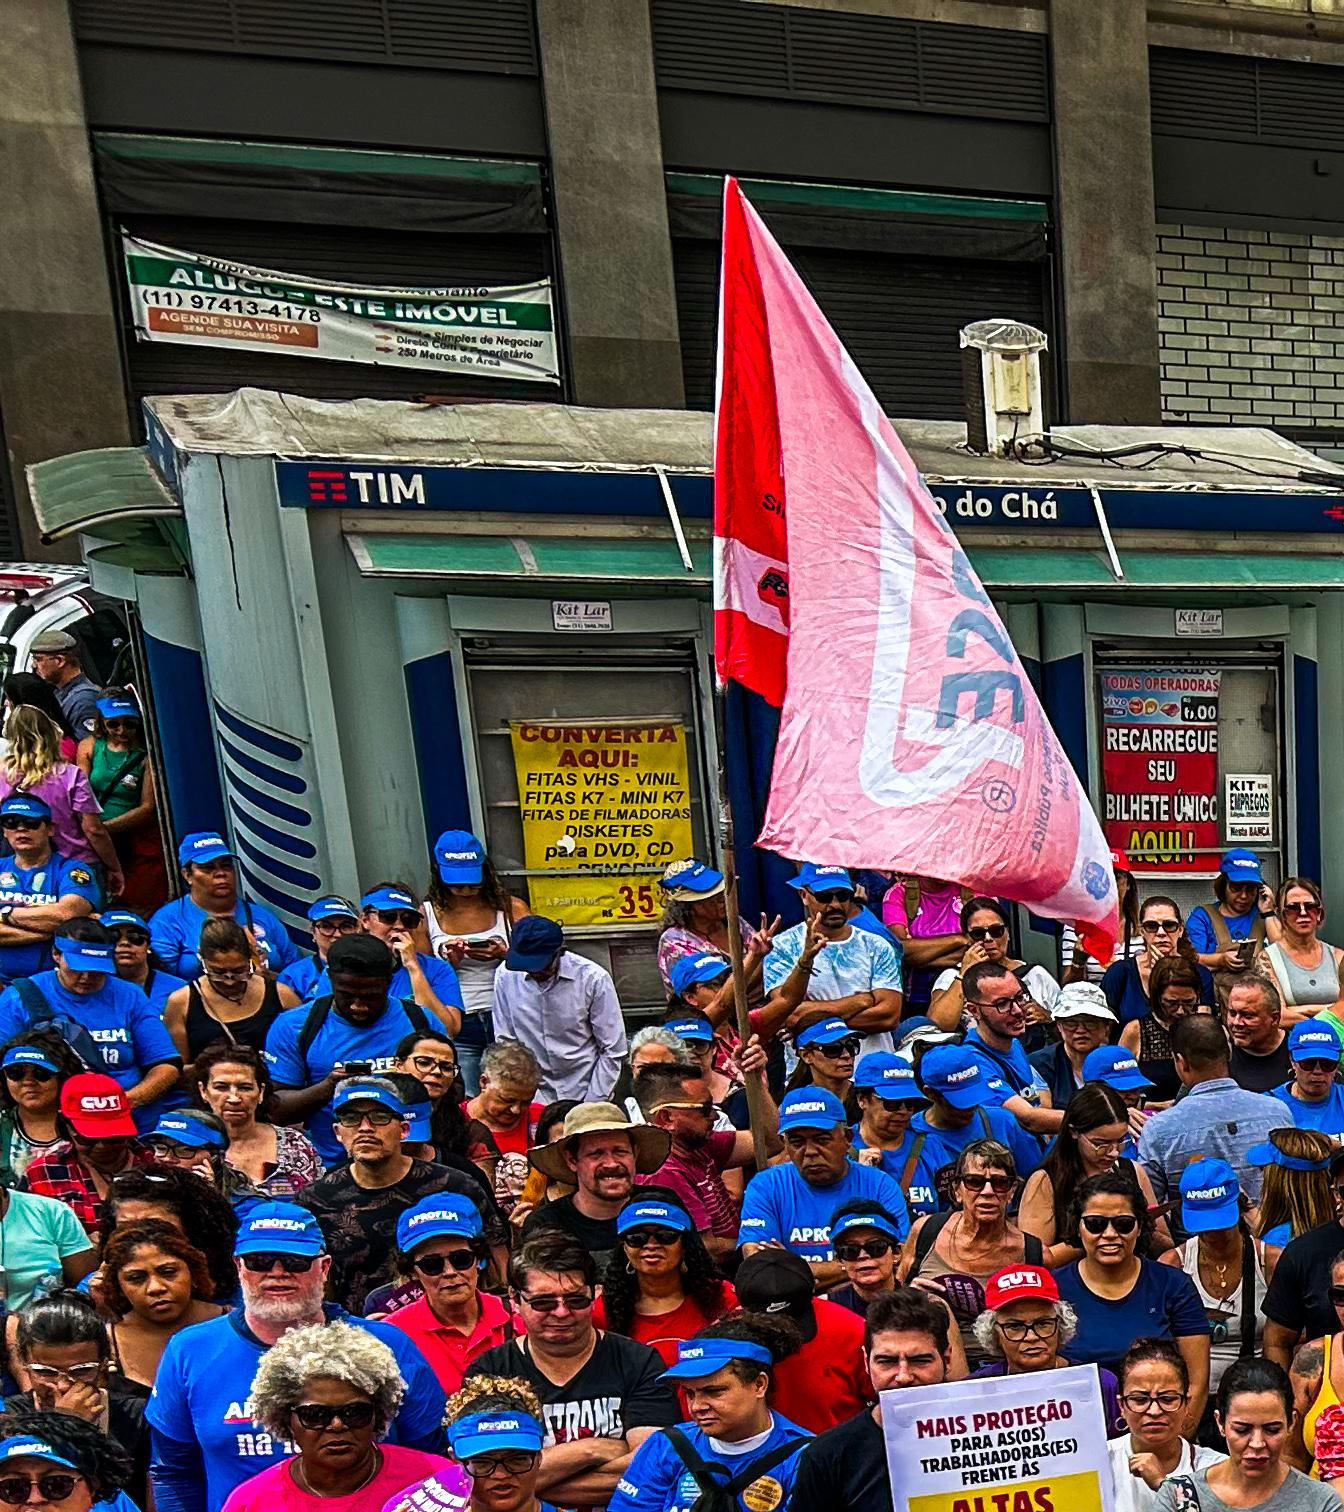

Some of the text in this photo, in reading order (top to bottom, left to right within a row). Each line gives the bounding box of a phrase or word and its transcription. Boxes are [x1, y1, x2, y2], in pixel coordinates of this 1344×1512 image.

[142, 289, 321, 323] (11) 97413-4178
[395, 301, 517, 325] IMÓVEL
[159, 311, 299, 335] AGENDE SUA VISITA
[496, 334, 544, 348] Negociar
[419, 349, 457, 361] Metros
[459, 353, 473, 363] de
[349, 472, 427, 505] TIM
[956, 491, 1058, 520] do Chá
[555, 602, 610, 617] Kit Lar
[1177, 610, 1222, 623] Kit Lar
[1103, 675, 1219, 692] TODAS OPERADORAS
[520, 725, 678, 744] CONVERTA
[1106, 728, 1218, 752] RECARREGUE
[557, 750, 639, 768] AQUI:
[526, 772, 680, 786] FITAS VHS VINIL
[1148, 759, 1175, 781] SEU
[1229, 780, 1255, 791] KIT
[525, 790, 685, 805] FITAS K7 MINI K7
[521, 808, 690, 821] FITAS DE FILMADORAS
[1107, 793, 1171, 822] BILHETE
[565, 824, 653, 838] DISKETES
[593, 842, 640, 860] DVD,
[647, 842, 674, 857] CD
[81, 1094, 123, 1111] CUT
[250, 1216, 306, 1233] APROFEM
[408, 1208, 459, 1227] APROFEM
[998, 1271, 1036, 1288] CUT
[916, 1398, 1073, 1439] MAIS PROTEÇÃO
[951, 1425, 1046, 1453] PARA AS(OS)
[920, 1438, 1078, 1474] TRABALHADORAS(ES)
[961, 1458, 1041, 1486] FRENTE ÀS
